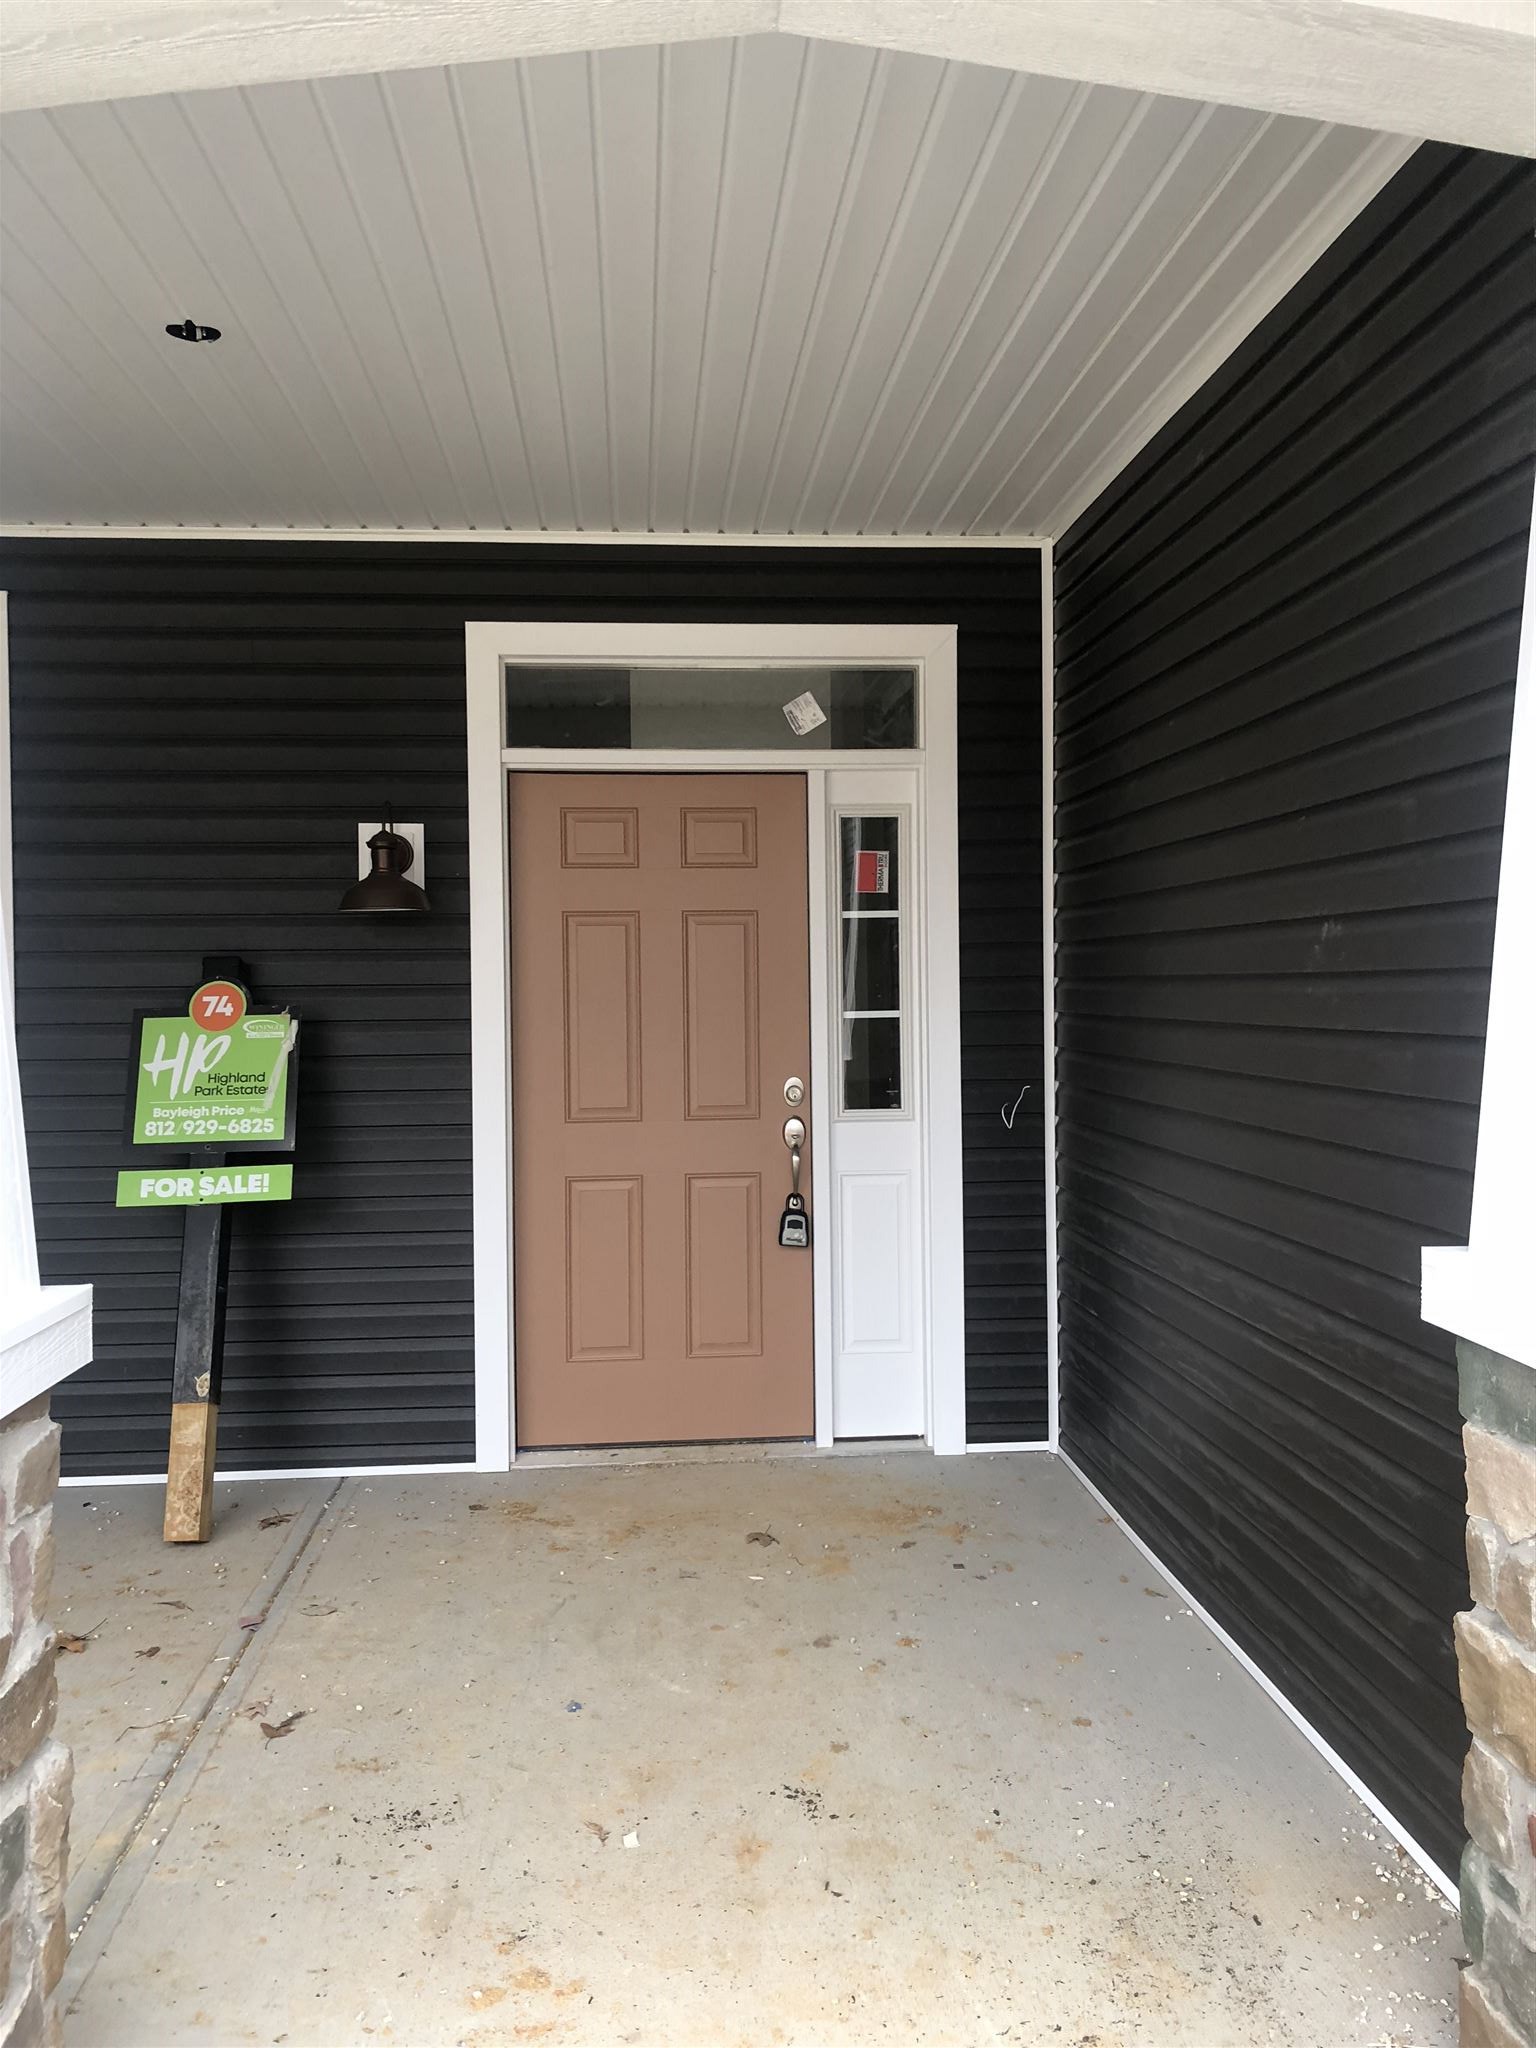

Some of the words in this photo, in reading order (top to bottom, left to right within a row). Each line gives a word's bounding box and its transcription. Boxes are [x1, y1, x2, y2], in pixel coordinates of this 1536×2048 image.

[202, 995, 234, 1017] 74
[143, 1031, 232, 1100] HP
[207, 1072, 266, 1086] Highland
[194, 1085, 223, 1096] Park
[227, 1083, 271, 1096] Estate
[153, 1106, 209, 1119] Bayleigh
[212, 1105, 245, 1116] Price
[140, 1177, 194, 1198] FOR
[199, 1173, 270, 1196] SALE!
